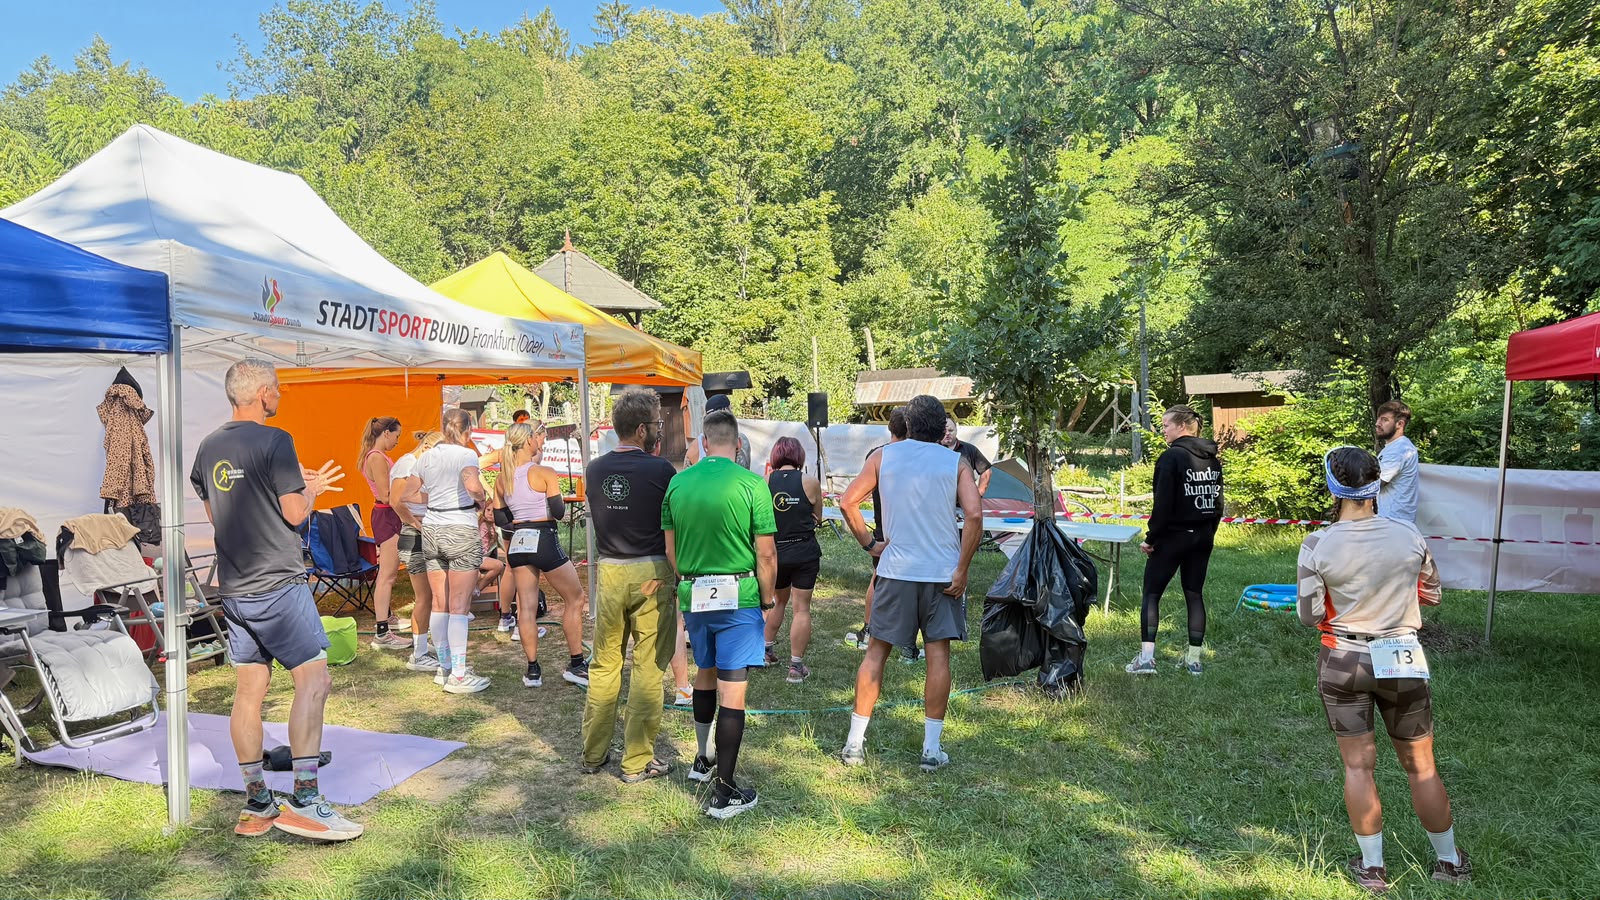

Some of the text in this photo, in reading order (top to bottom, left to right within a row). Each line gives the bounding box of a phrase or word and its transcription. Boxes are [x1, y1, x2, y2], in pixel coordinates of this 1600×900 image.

[316, 299, 470, 346] STADTSPORTBUND
[470, 326, 517, 352] Frankfurt
[516, 332, 545, 358] (Oder)
[1186, 466, 1220, 482] Sunday
[1183, 481, 1221, 498] Runnig
[518, 537, 525, 546] 4
[709, 587, 718, 600] 2
[1392, 649, 1414, 665] 13
